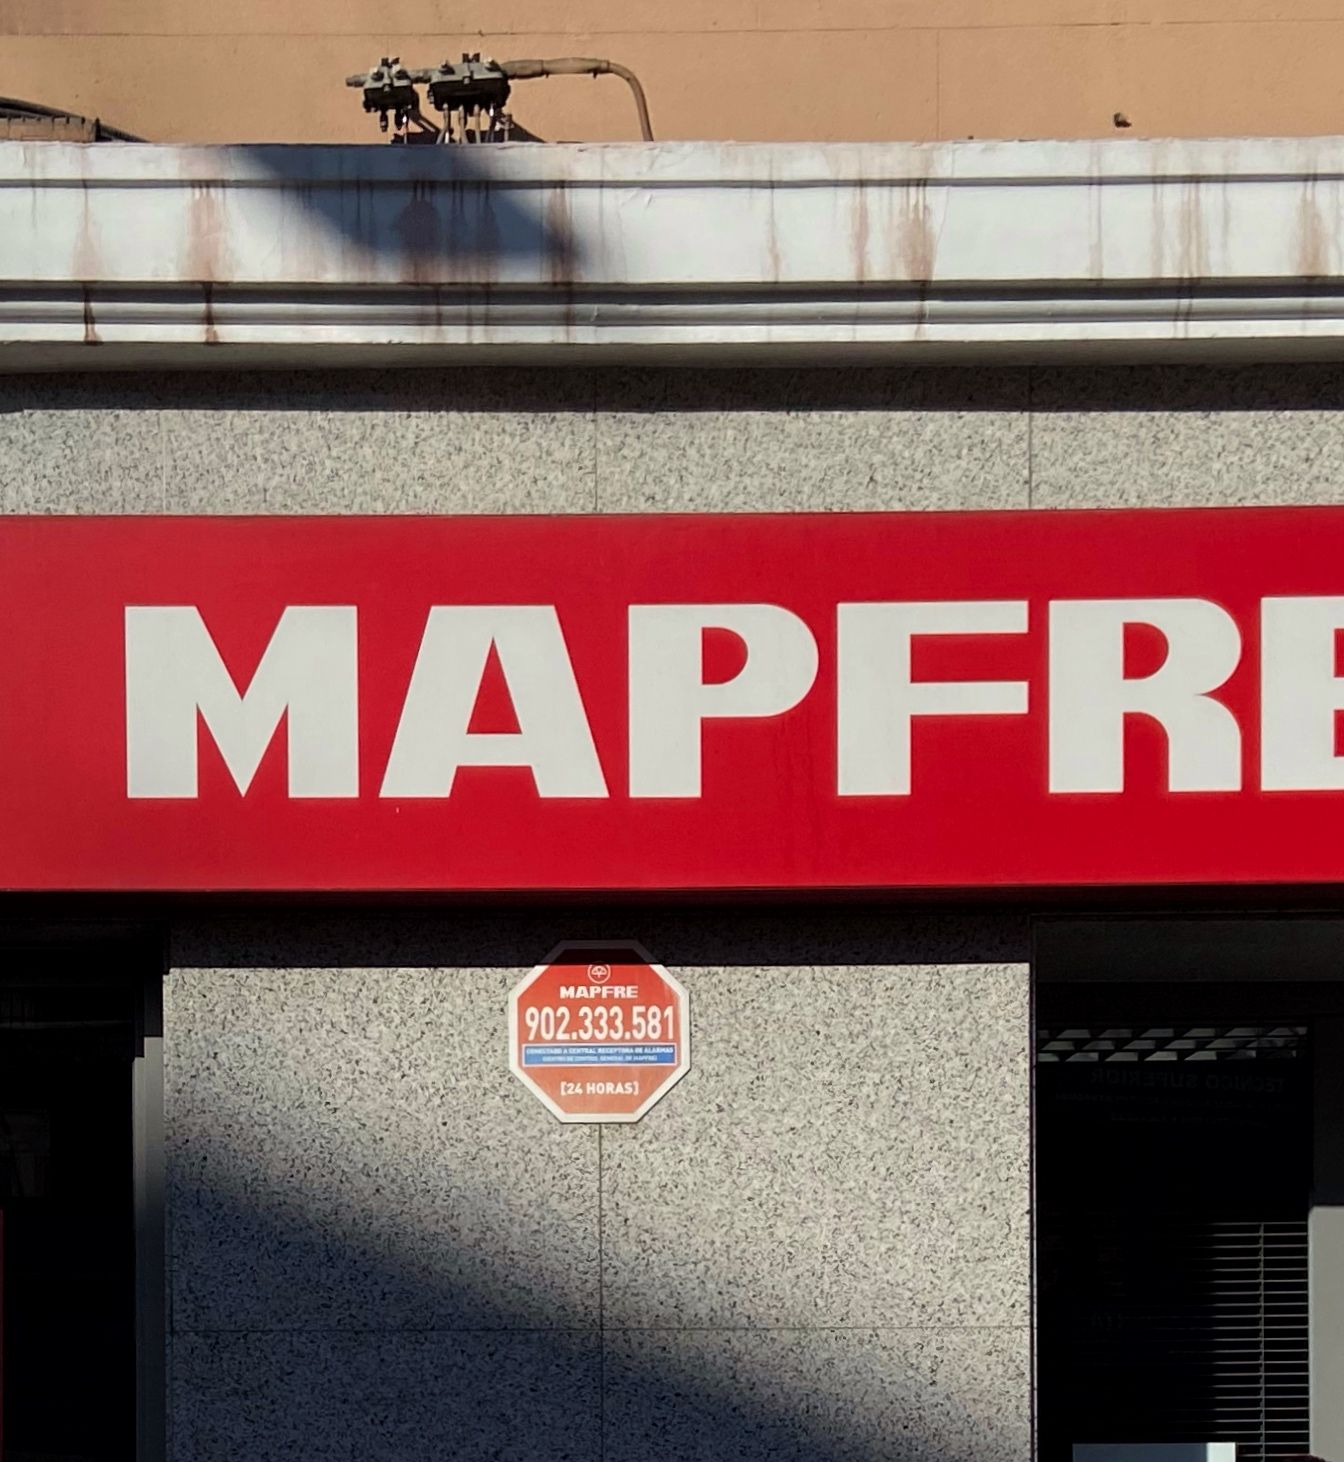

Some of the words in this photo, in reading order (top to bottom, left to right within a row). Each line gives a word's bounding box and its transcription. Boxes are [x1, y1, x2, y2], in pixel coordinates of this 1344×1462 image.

[559, 985, 639, 999] MAPFRE
[525, 1006, 674, 1040] 902.333.581
[560, 1081, 583, 1095] [24
[586, 1081, 639, 1095] HORAS]
